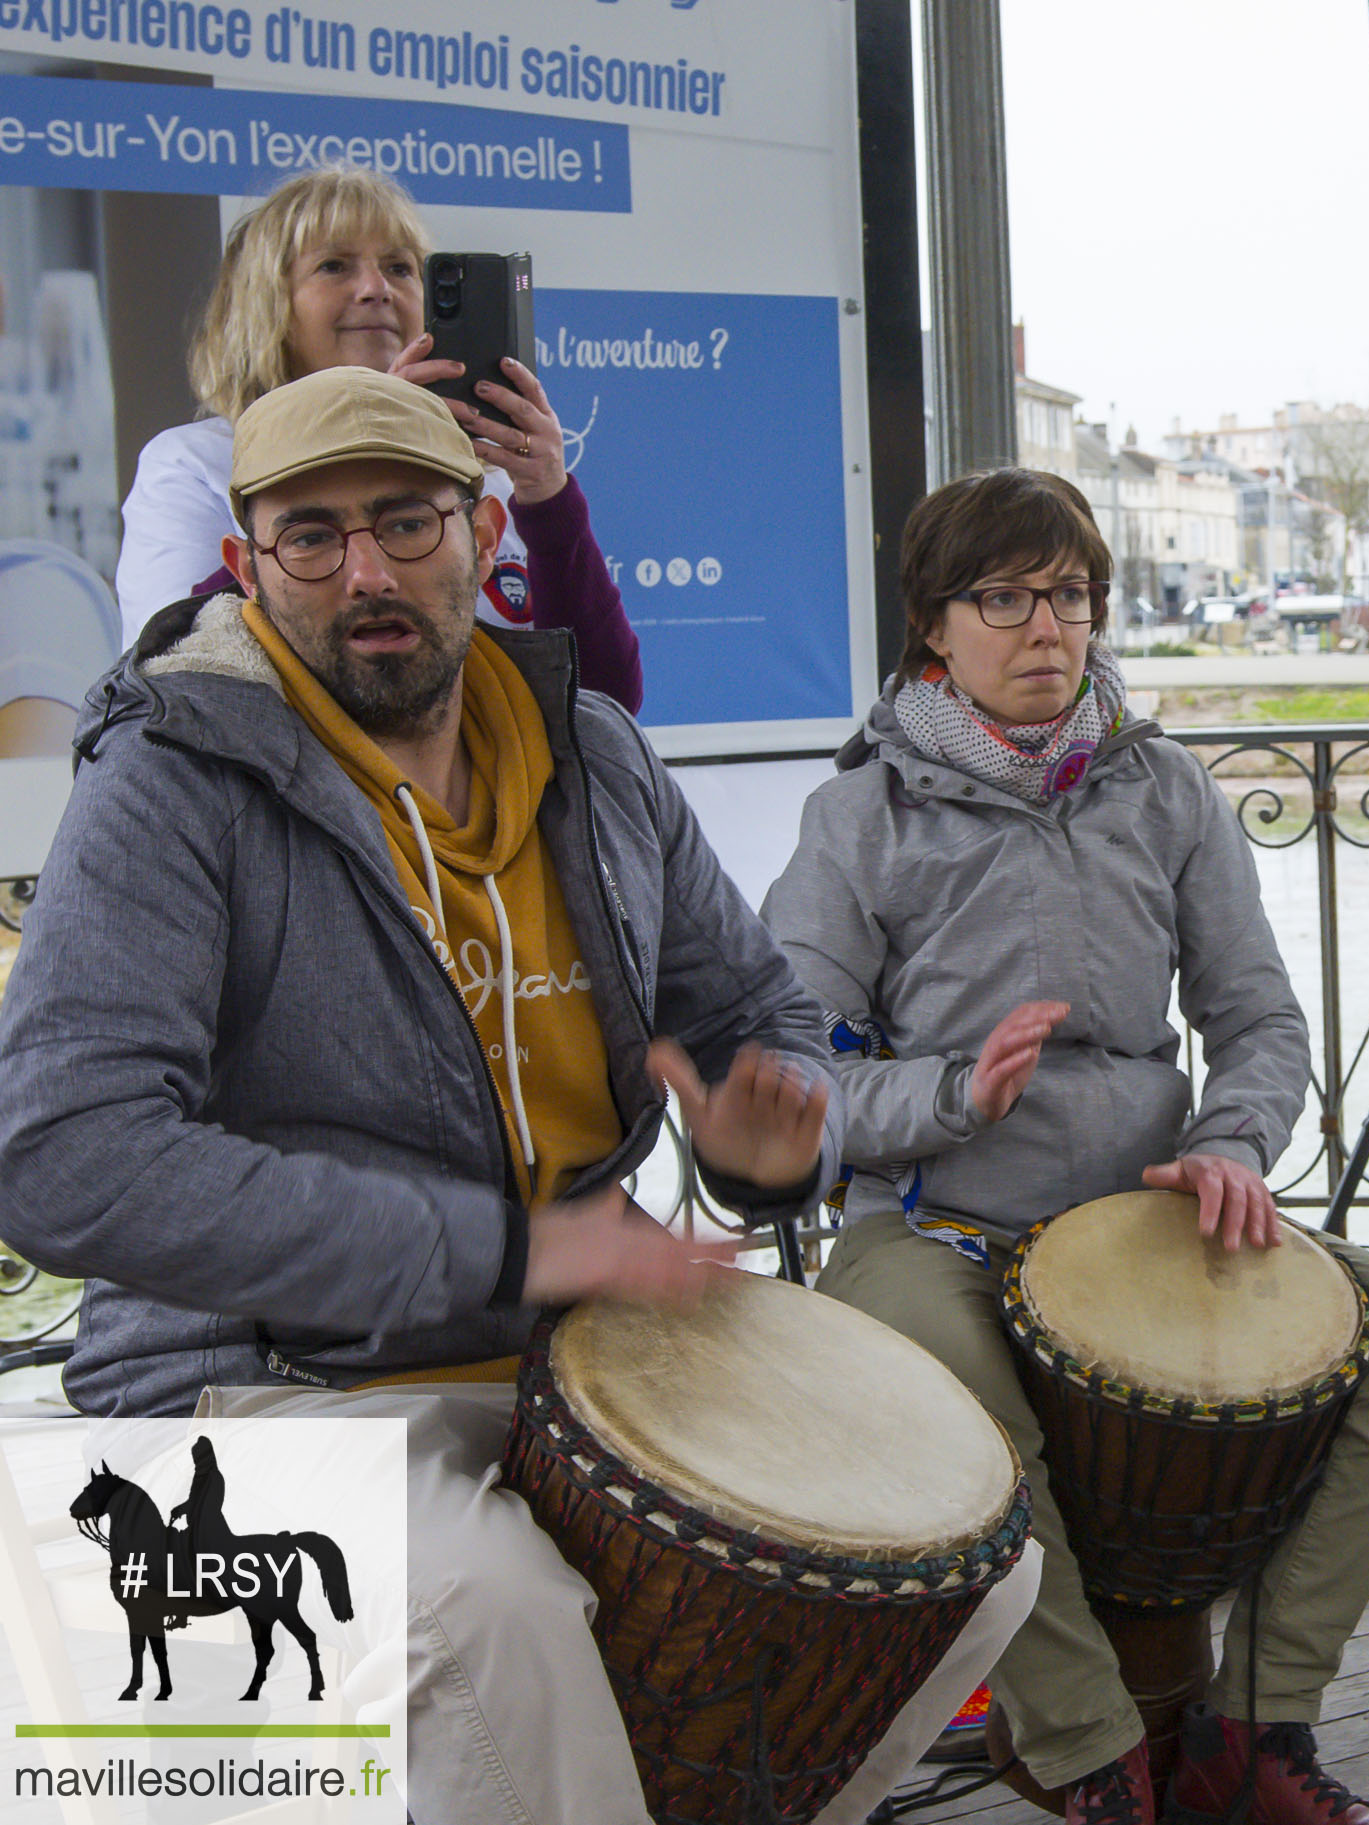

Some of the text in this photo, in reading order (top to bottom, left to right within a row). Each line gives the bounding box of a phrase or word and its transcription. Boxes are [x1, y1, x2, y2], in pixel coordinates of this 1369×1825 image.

[265, 7, 356, 72] d'un
[369, 27, 510, 91] emploi
[521, 45, 725, 117] saisonnier
[558, 326, 705, 370] l'aventure
[709, 327, 729, 370] ?
[290, 1367, 329, 1387] SUBLEVEL
